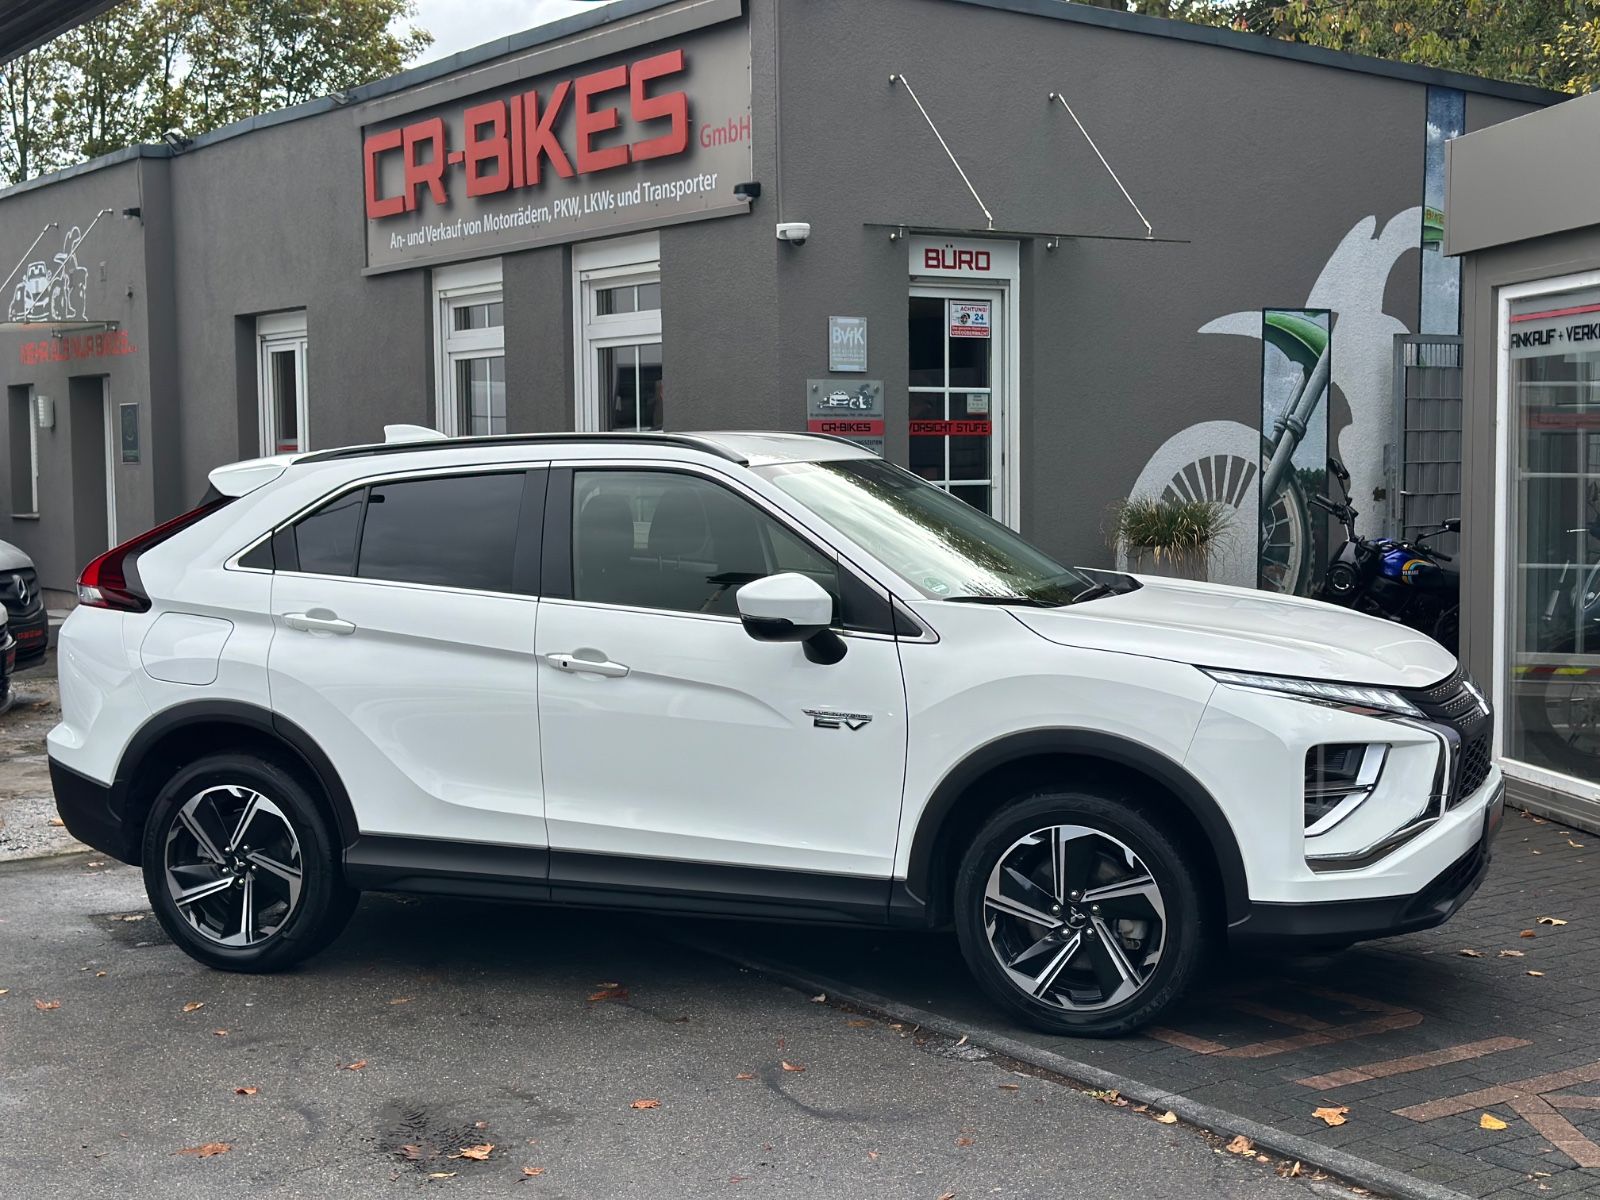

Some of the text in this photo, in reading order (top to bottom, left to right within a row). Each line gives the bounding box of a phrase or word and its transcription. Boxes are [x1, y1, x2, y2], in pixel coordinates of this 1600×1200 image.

[364, 49, 751, 218] CR-BIKES GmbH
[390, 172, 718, 249] An- und Verkauf von Motorrädern, PKW, LKWs und Transporter
[924, 244, 991, 271] BÜRO
[974, 313, 984, 321] 24
[1511, 328, 1556, 349] ANKAUF
[1565, 323, 1600, 342] VERK
[821, 422, 871, 432] CR-BIKES
[956, 422, 988, 433] STUFE
